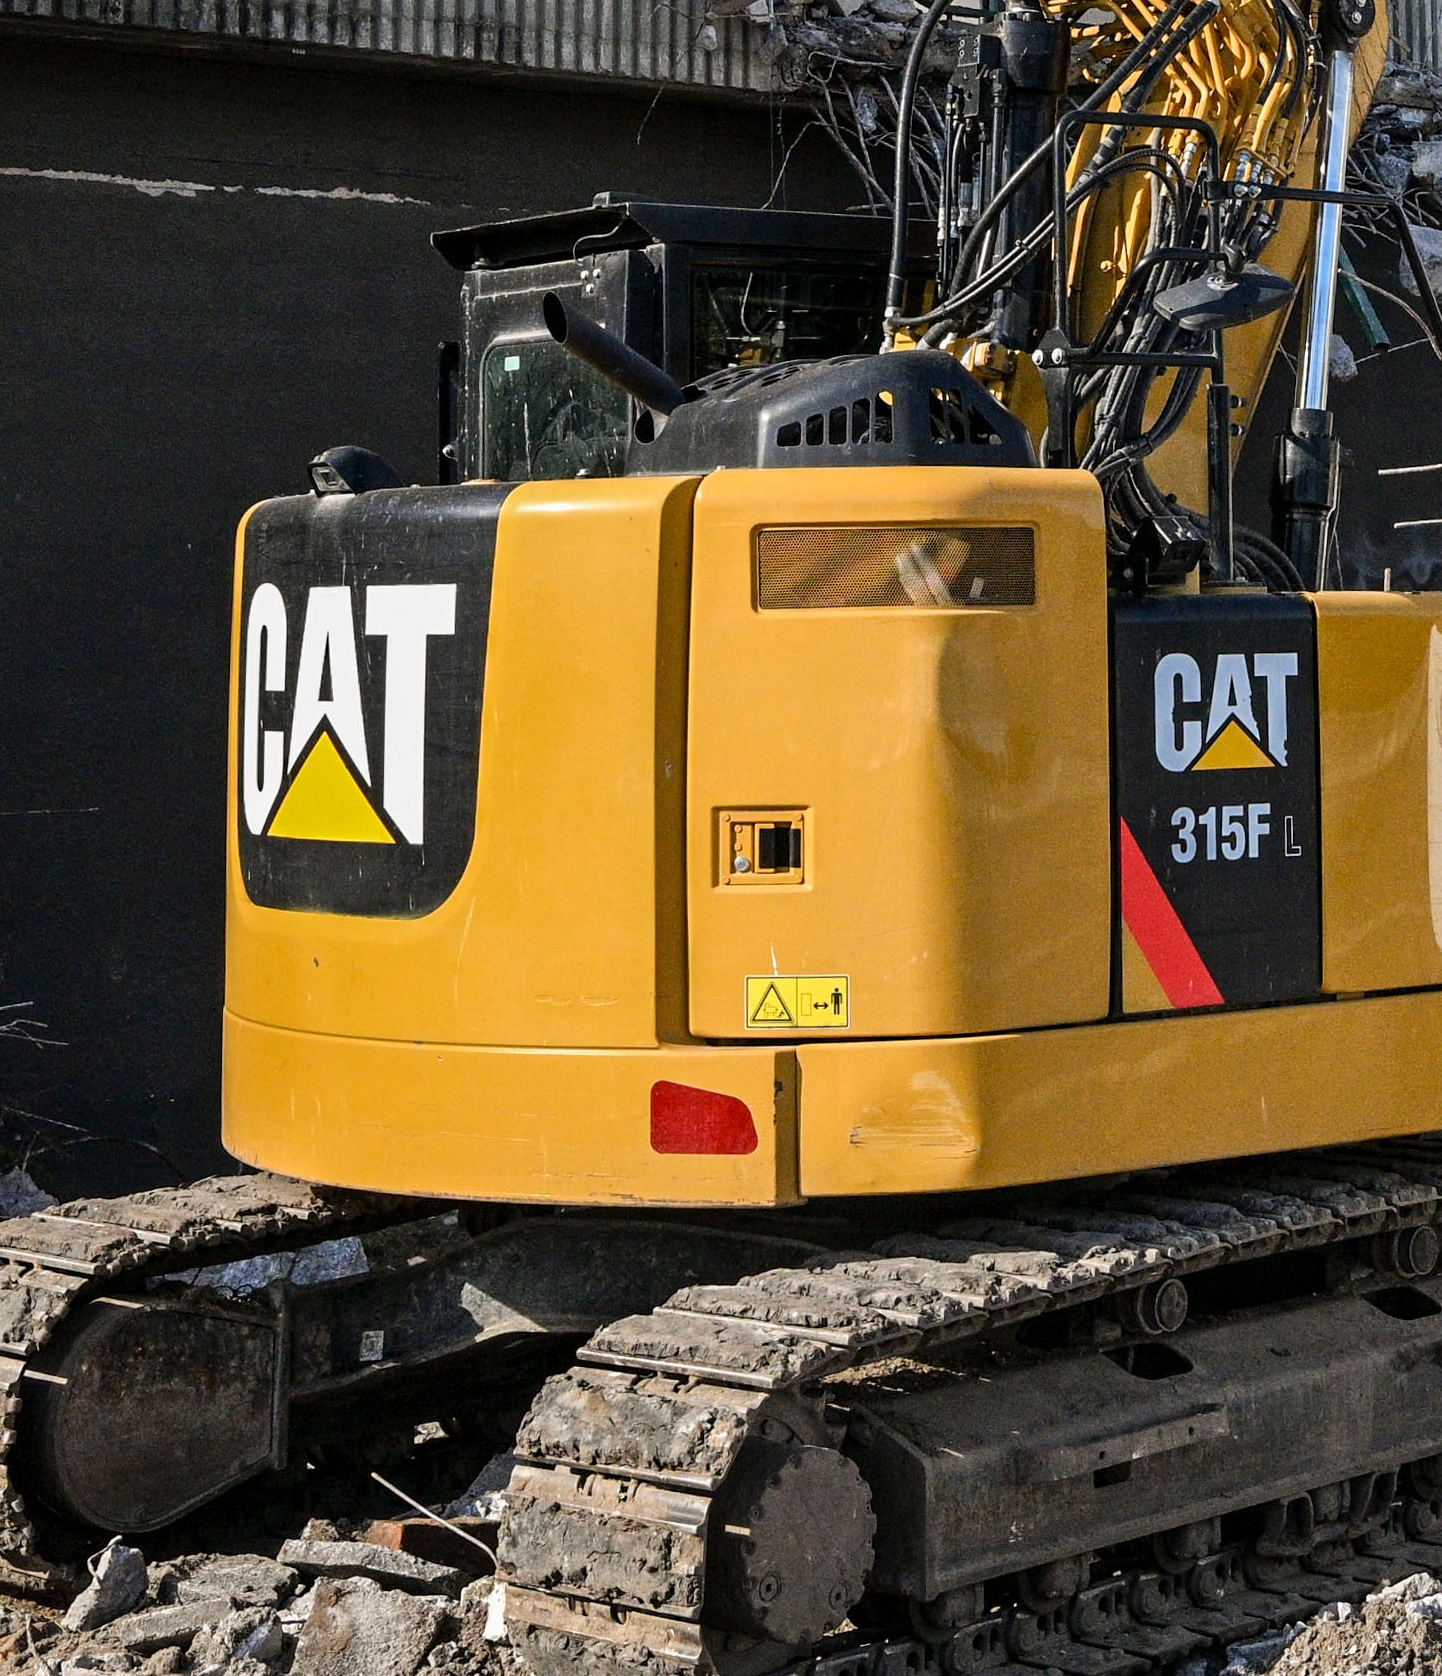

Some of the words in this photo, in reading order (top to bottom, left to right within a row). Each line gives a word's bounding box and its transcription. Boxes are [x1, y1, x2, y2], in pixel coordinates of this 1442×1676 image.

[243, 582, 457, 845] CAT
[1154, 652, 1298, 772] CAT
[1171, 803, 1271, 864] 315F
[1284, 816, 1301, 856] L
